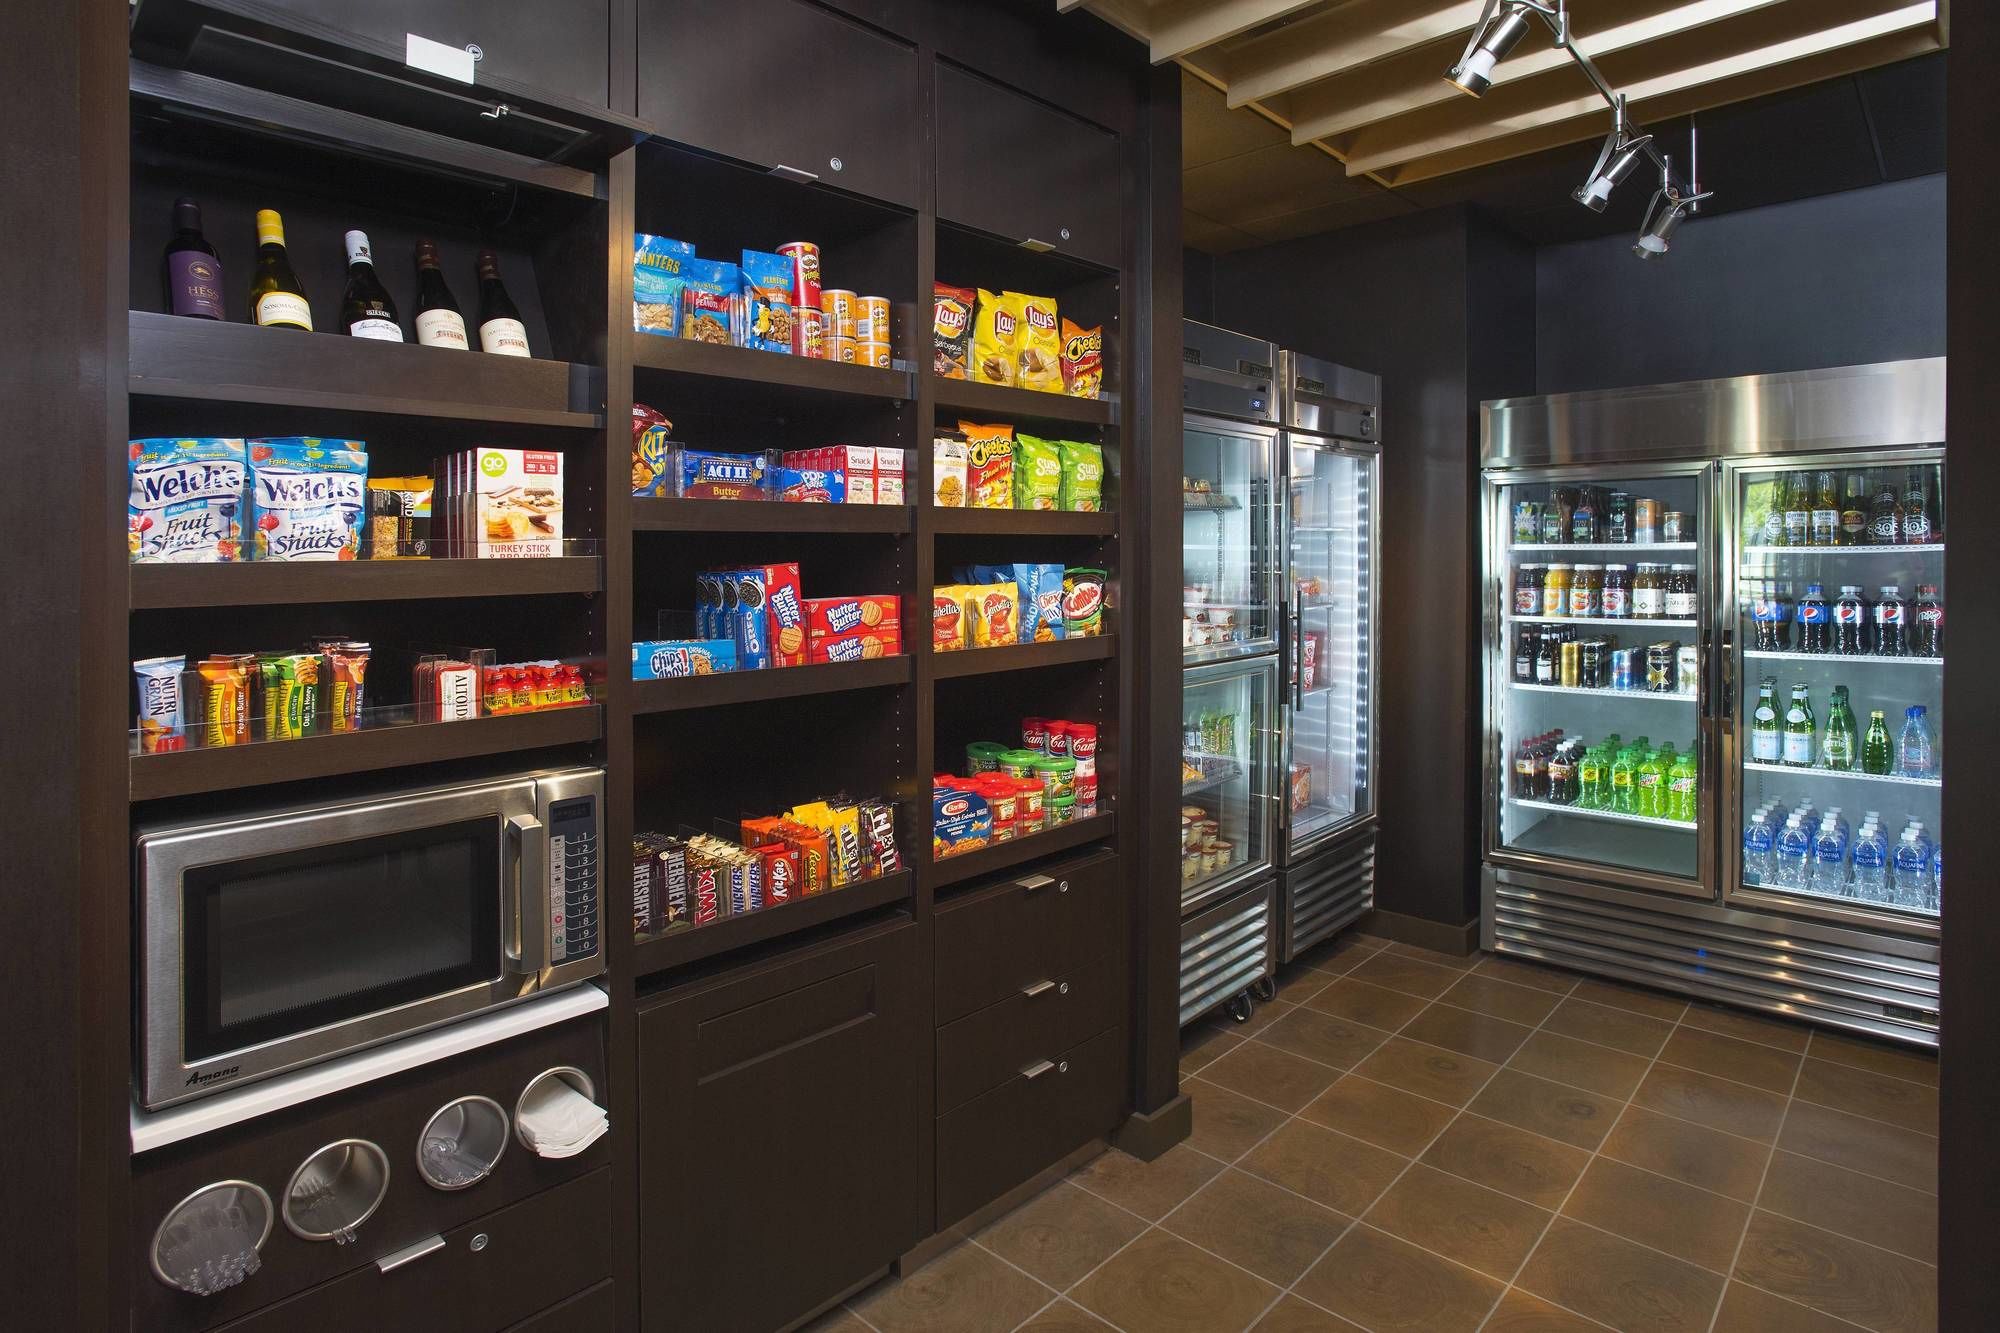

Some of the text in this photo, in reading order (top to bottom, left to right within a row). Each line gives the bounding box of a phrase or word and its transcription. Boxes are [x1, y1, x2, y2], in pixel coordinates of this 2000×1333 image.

[636, 250, 681, 274] ANTERS
[188, 286, 219, 299] HESS
[935, 304, 966, 331] Lay's
[1027, 306, 1055, 329] Lay's
[850, 456, 872, 465] Snack
[880, 457, 901, 466] Snack
[970, 436, 1012, 468] Cheetos
[484, 457, 504, 472] go
[707, 465, 748, 479] ACT II
[1077, 462, 1098, 481] Sun
[139, 465, 240, 503] Welch's
[260, 477, 360, 502] Welch's
[713, 486, 741, 496] Butter
[403, 491, 414, 517] KIND
[166, 512, 213, 537] Fruit
[1874, 523, 1899, 536] 805
[1902, 521, 1929, 535] 805
[149, 528, 222, 555] Snacks
[275, 533, 346, 555] Snacks
[489, 544, 551, 553] TURKEY STICK
[770, 592, 793, 629] Butter
[780, 584, 801, 622] Nutter
[827, 601, 858, 622] Nutter
[831, 609, 862, 632] Butter
[746, 611, 760, 654] OREO
[687, 646, 713, 659] ORIGINAL
[827, 637, 859, 659] Nutter
[651, 651, 682, 675] Chips
[148, 678, 165, 717] GRAIN
[160, 676, 177, 714] NUTRI
[304, 686, 313, 704] Honey
[303, 712, 311, 727] Oats
[582, 832, 587, 840] 1
[582, 844, 588, 853] 2
[582, 856, 588, 865] 3
[582, 869, 588, 877] 4
[668, 850, 687, 914] HERSHEY'S
[582, 882, 588, 890] 5
[634, 862, 650, 927] HERSHEY'S
[732, 866, 745, 914] NICKERS
[582, 894, 588, 902] 6
[694, 869, 718, 928] TWIX
[583, 906, 589, 914] 7
[584, 918, 589, 926] 8
[584, 930, 590, 938] 9
[584, 942, 590, 950] 0
[185, 1065, 241, 1087] Amana
